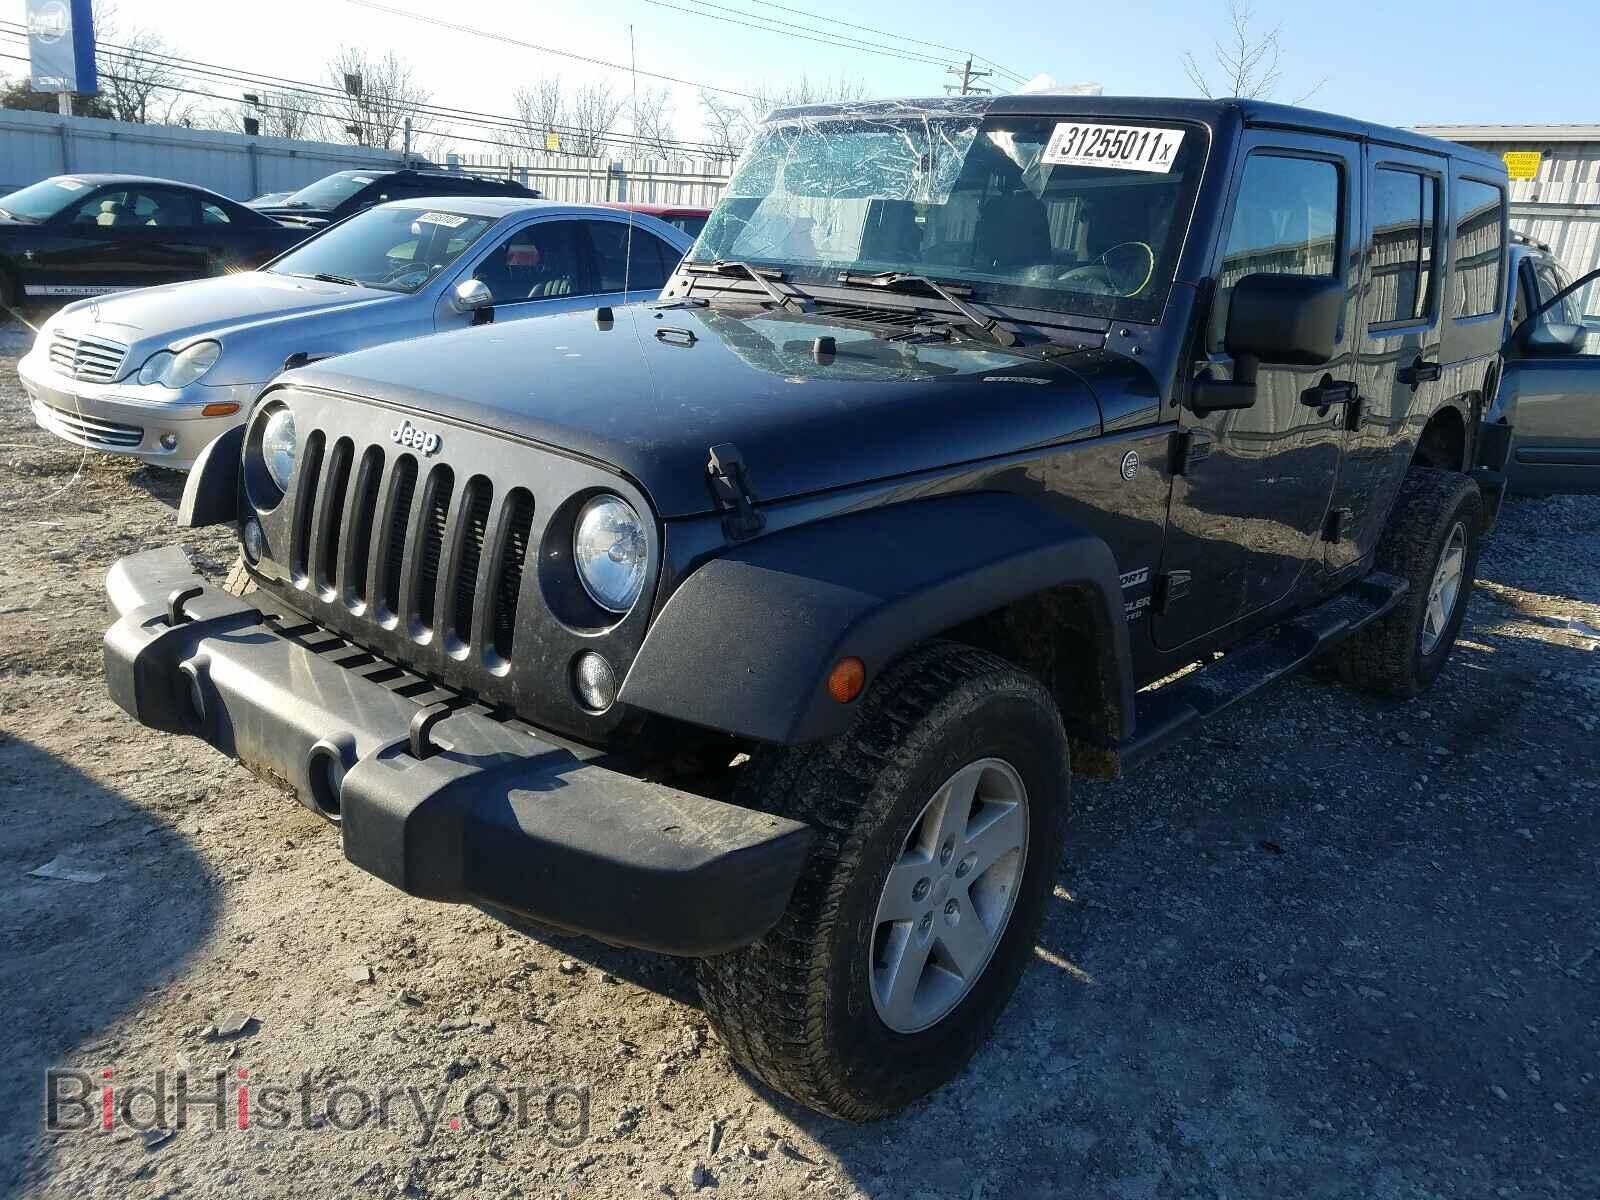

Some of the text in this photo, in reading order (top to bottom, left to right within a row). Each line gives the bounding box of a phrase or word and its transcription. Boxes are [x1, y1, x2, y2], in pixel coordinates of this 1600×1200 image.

[1061, 126, 1163, 162] 31255011
[391, 420, 441, 456] Jeep
[1120, 570, 1148, 587] ORT
